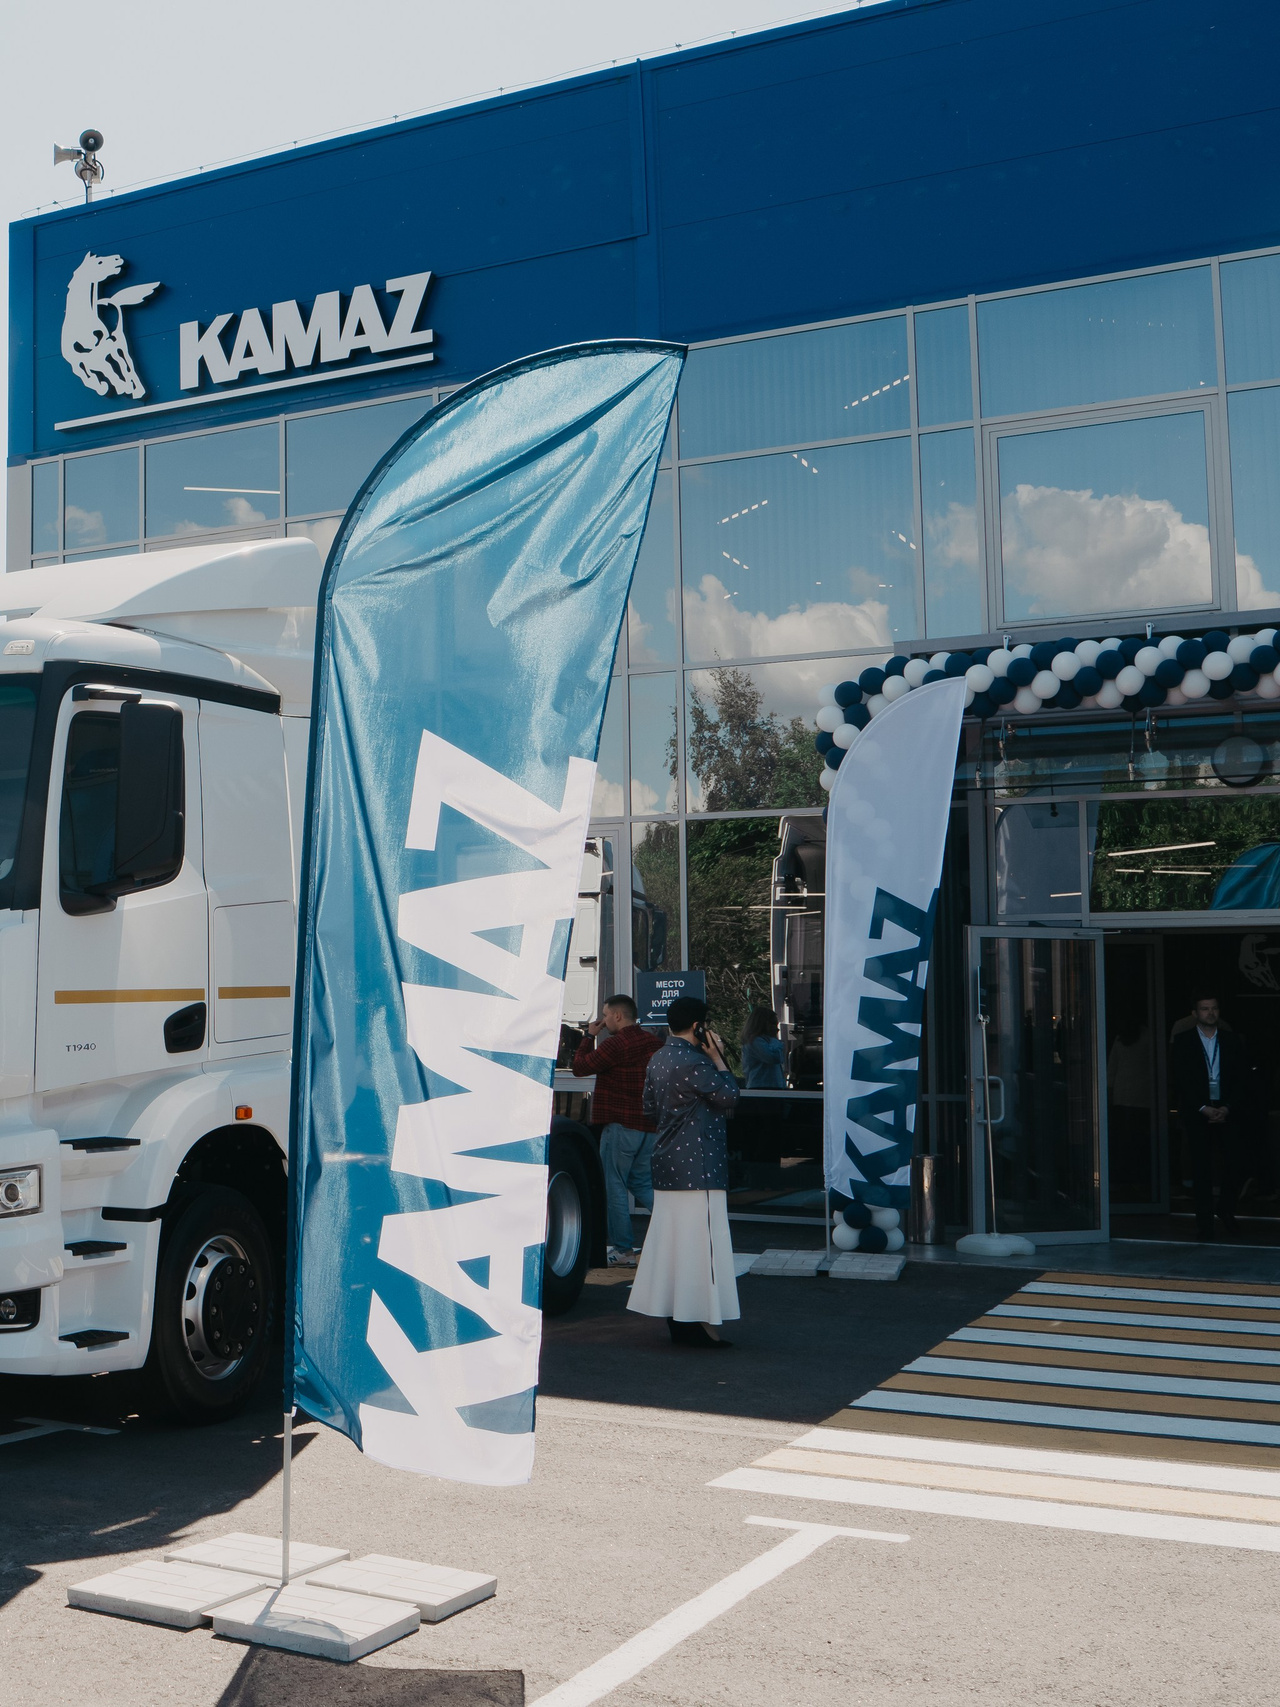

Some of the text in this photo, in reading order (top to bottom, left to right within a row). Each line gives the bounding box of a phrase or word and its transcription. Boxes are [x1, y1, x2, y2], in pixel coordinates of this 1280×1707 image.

[179, 271, 434, 391] KAMAZ
[655, 980, 685, 988] МЕСТО
[661, 989, 680, 999] ДЛЯ
[651, 999, 675, 1007] КУРЕ
[65, 1042, 97, 1053] T1940
[842, 887, 939, 1209] KAMAZ
[359, 728, 596, 1485] KAMAZ
